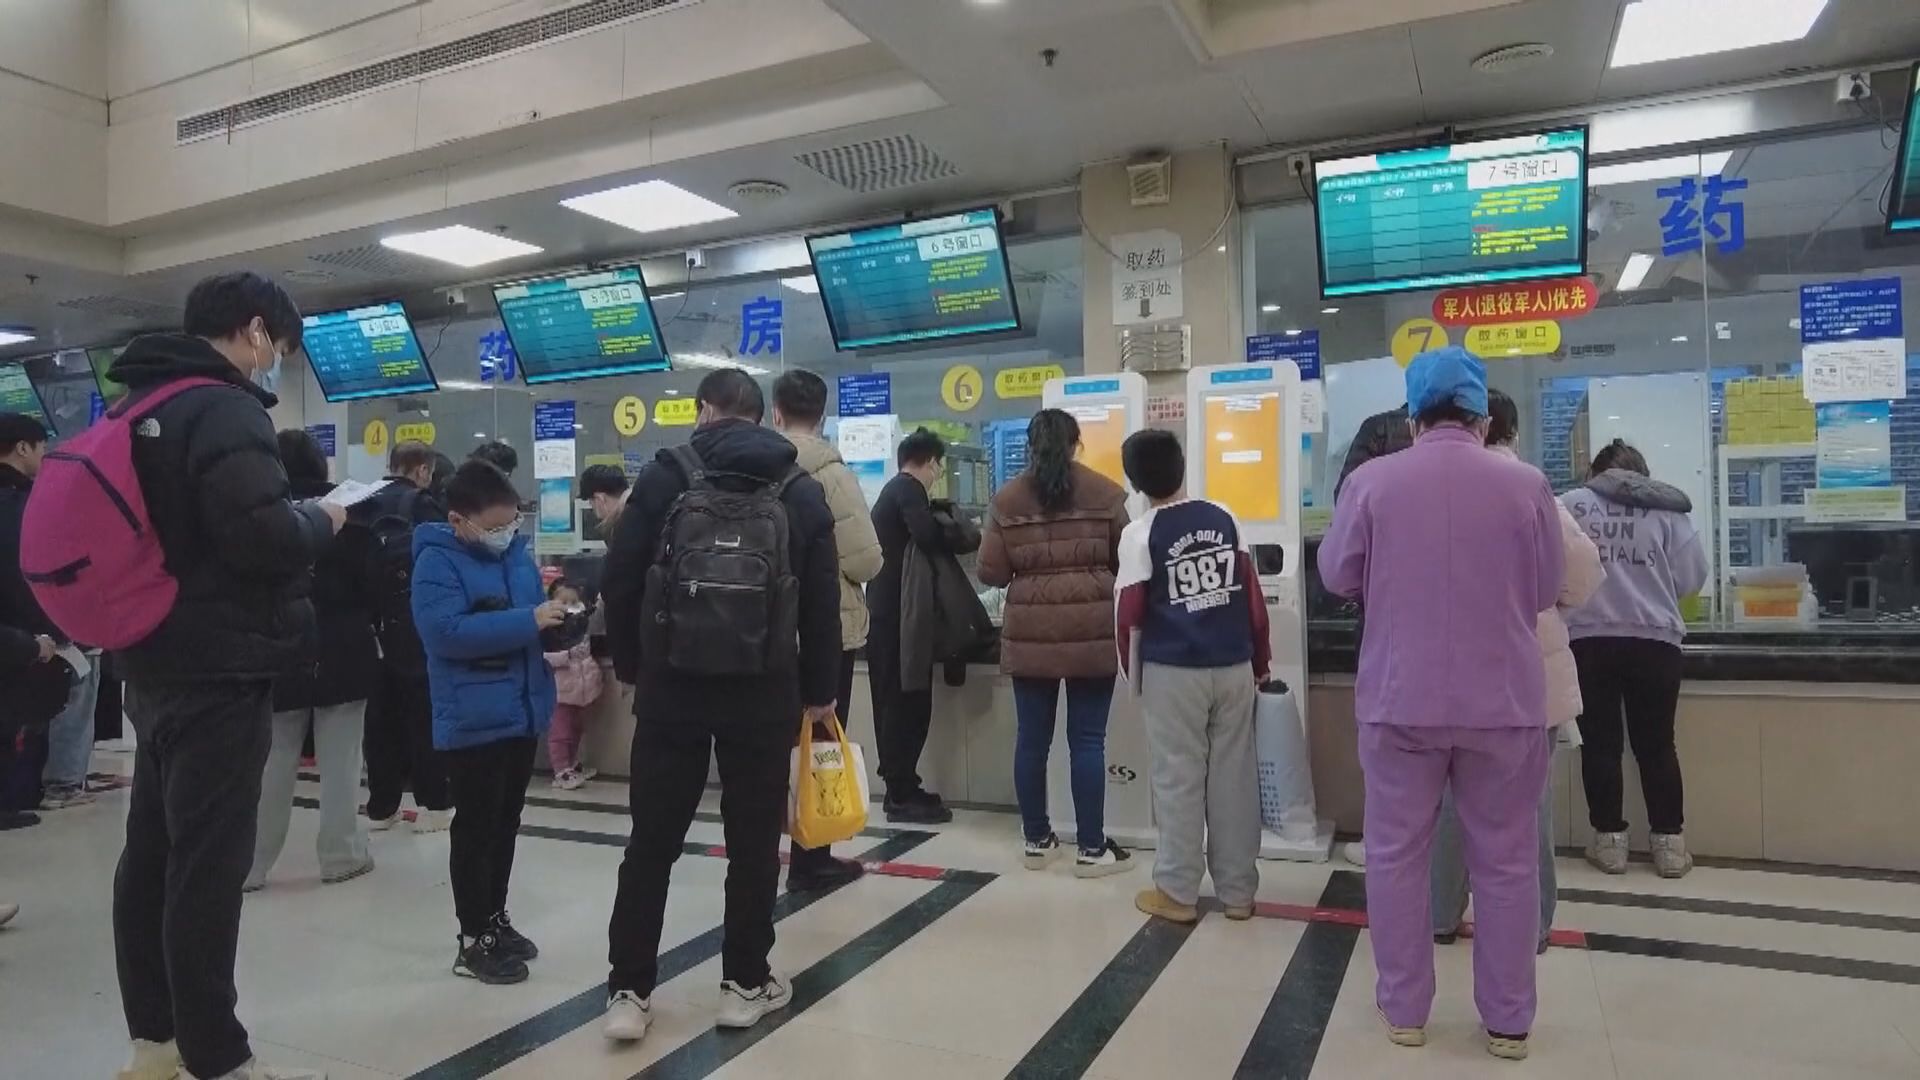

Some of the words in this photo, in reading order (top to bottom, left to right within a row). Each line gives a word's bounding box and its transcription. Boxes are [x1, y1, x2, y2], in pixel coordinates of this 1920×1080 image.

[1656, 174, 1748, 257] 药
[1126, 247, 1166, 271] 取药
[1122, 278, 1171, 301] 签到处
[738, 295, 783, 356] 房
[1408, 326, 1433, 353] 7
[954, 371, 973, 403] 6
[624, 402, 638, 430] 5
[371, 425, 382, 446] 4
[1589, 521, 1634, 540] SUN
[1167, 549, 1236, 600] 1987
